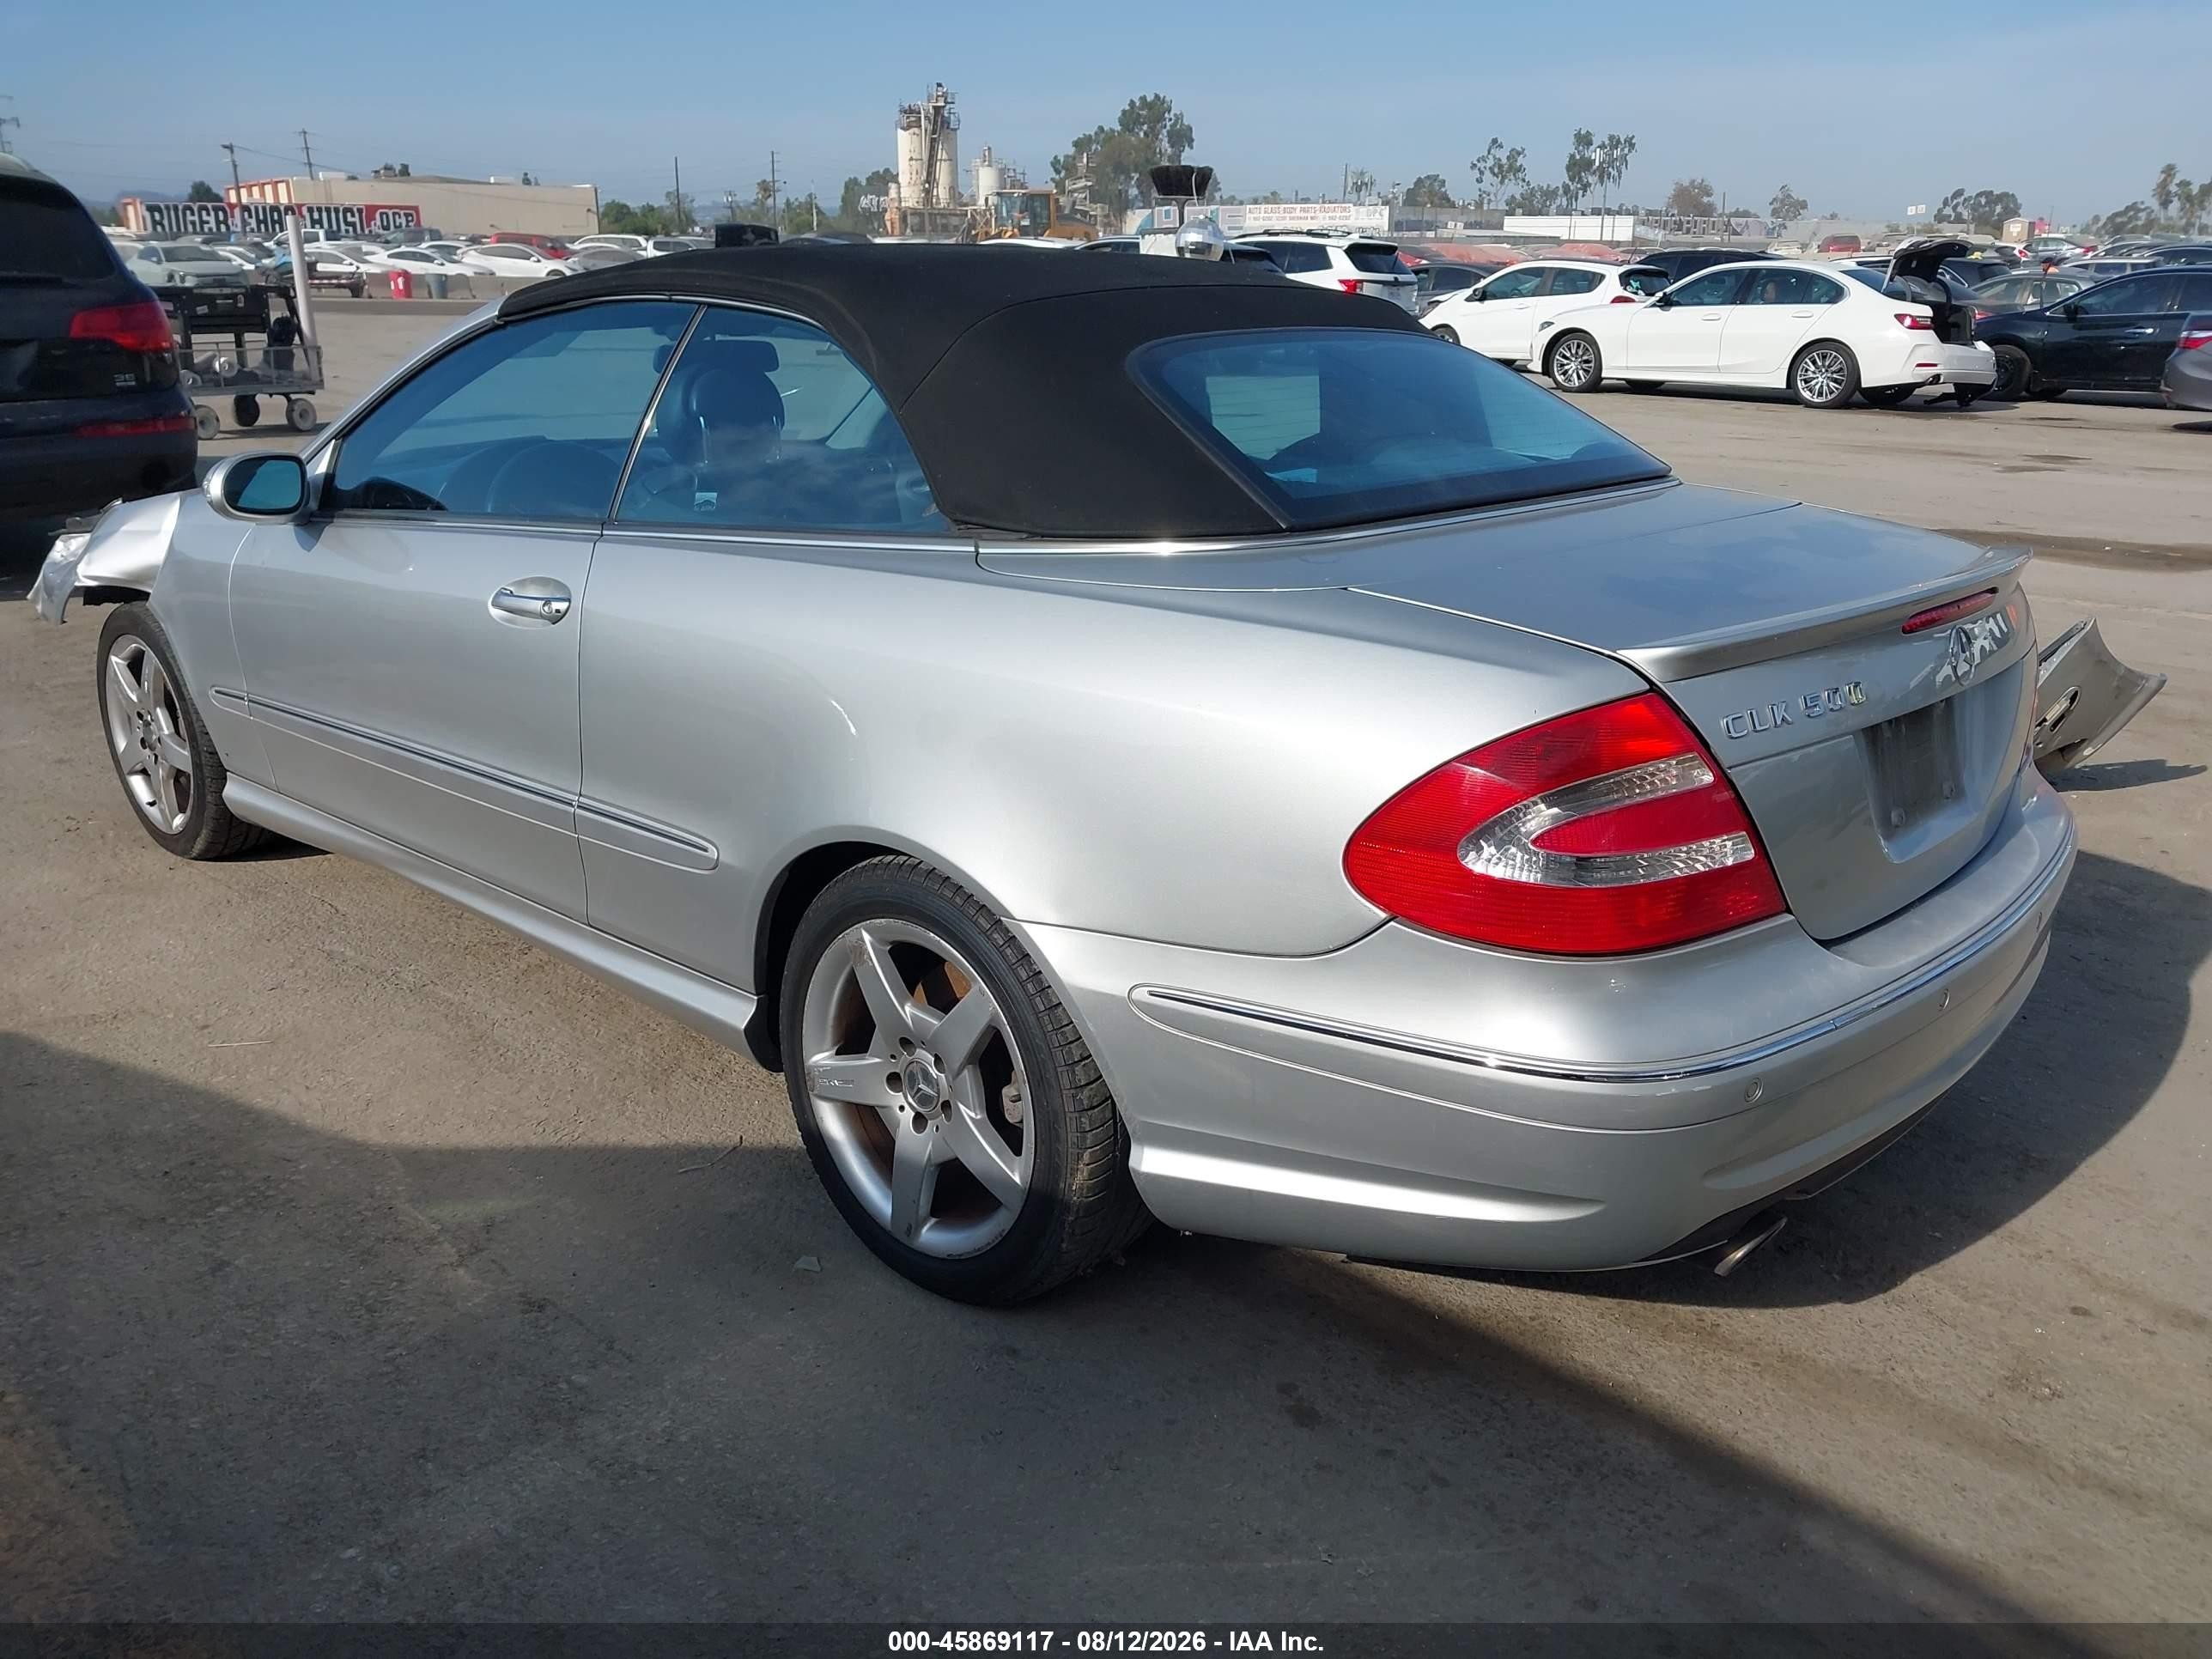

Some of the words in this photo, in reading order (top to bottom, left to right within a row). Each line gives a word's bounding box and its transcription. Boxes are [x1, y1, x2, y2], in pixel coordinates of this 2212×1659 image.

[1248, 206, 1261, 215] AUTO
[1722, 701, 1794, 739] CLK
[1800, 681, 1867, 718] 500
